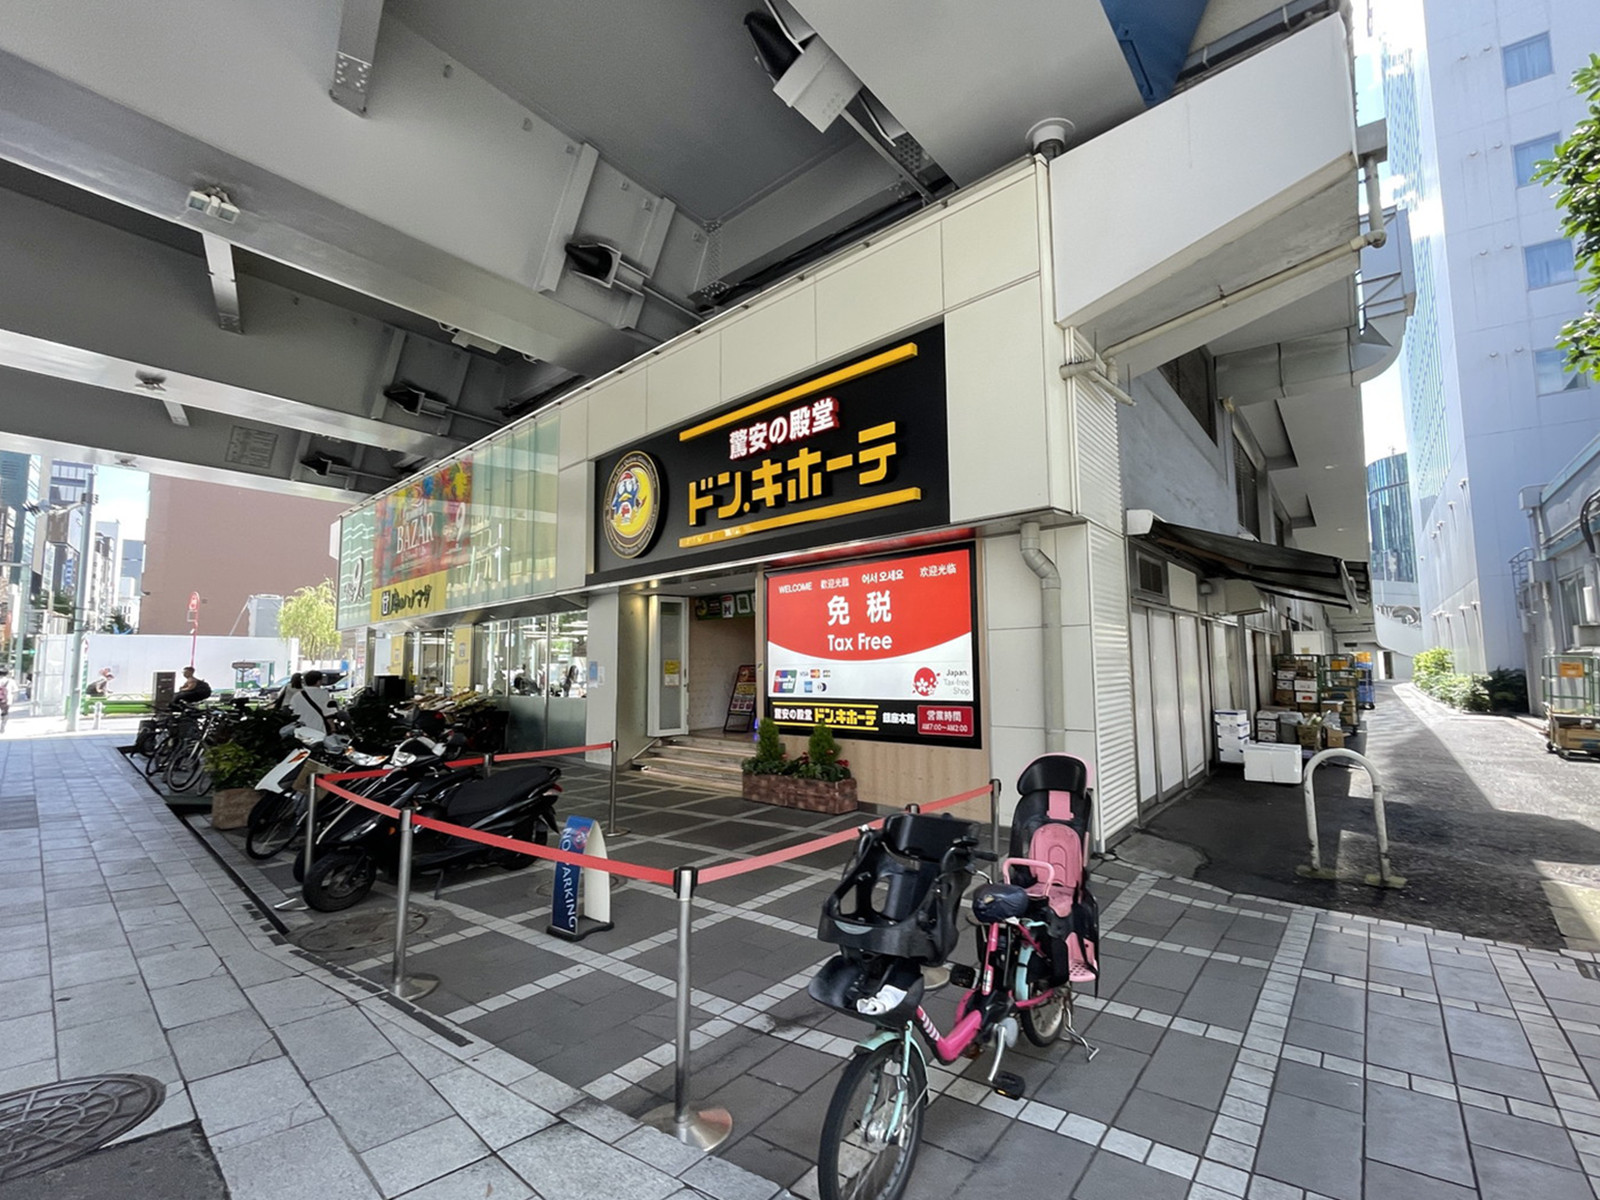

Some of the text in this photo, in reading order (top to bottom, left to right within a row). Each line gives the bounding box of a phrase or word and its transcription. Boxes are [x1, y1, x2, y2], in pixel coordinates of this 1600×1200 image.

[729, 396, 836, 460] 驚安の殿堂
[396, 512, 434, 554] BAZAR
[919, 563, 957, 577] 欢迎光临
[778, 582, 812, 593] WELCOME
[827, 632, 893, 651] Tax Free
[952, 687, 970, 696] Shop
[926, 710, 962, 722] 営業時間
[562, 827, 578, 928] NO ARKING
